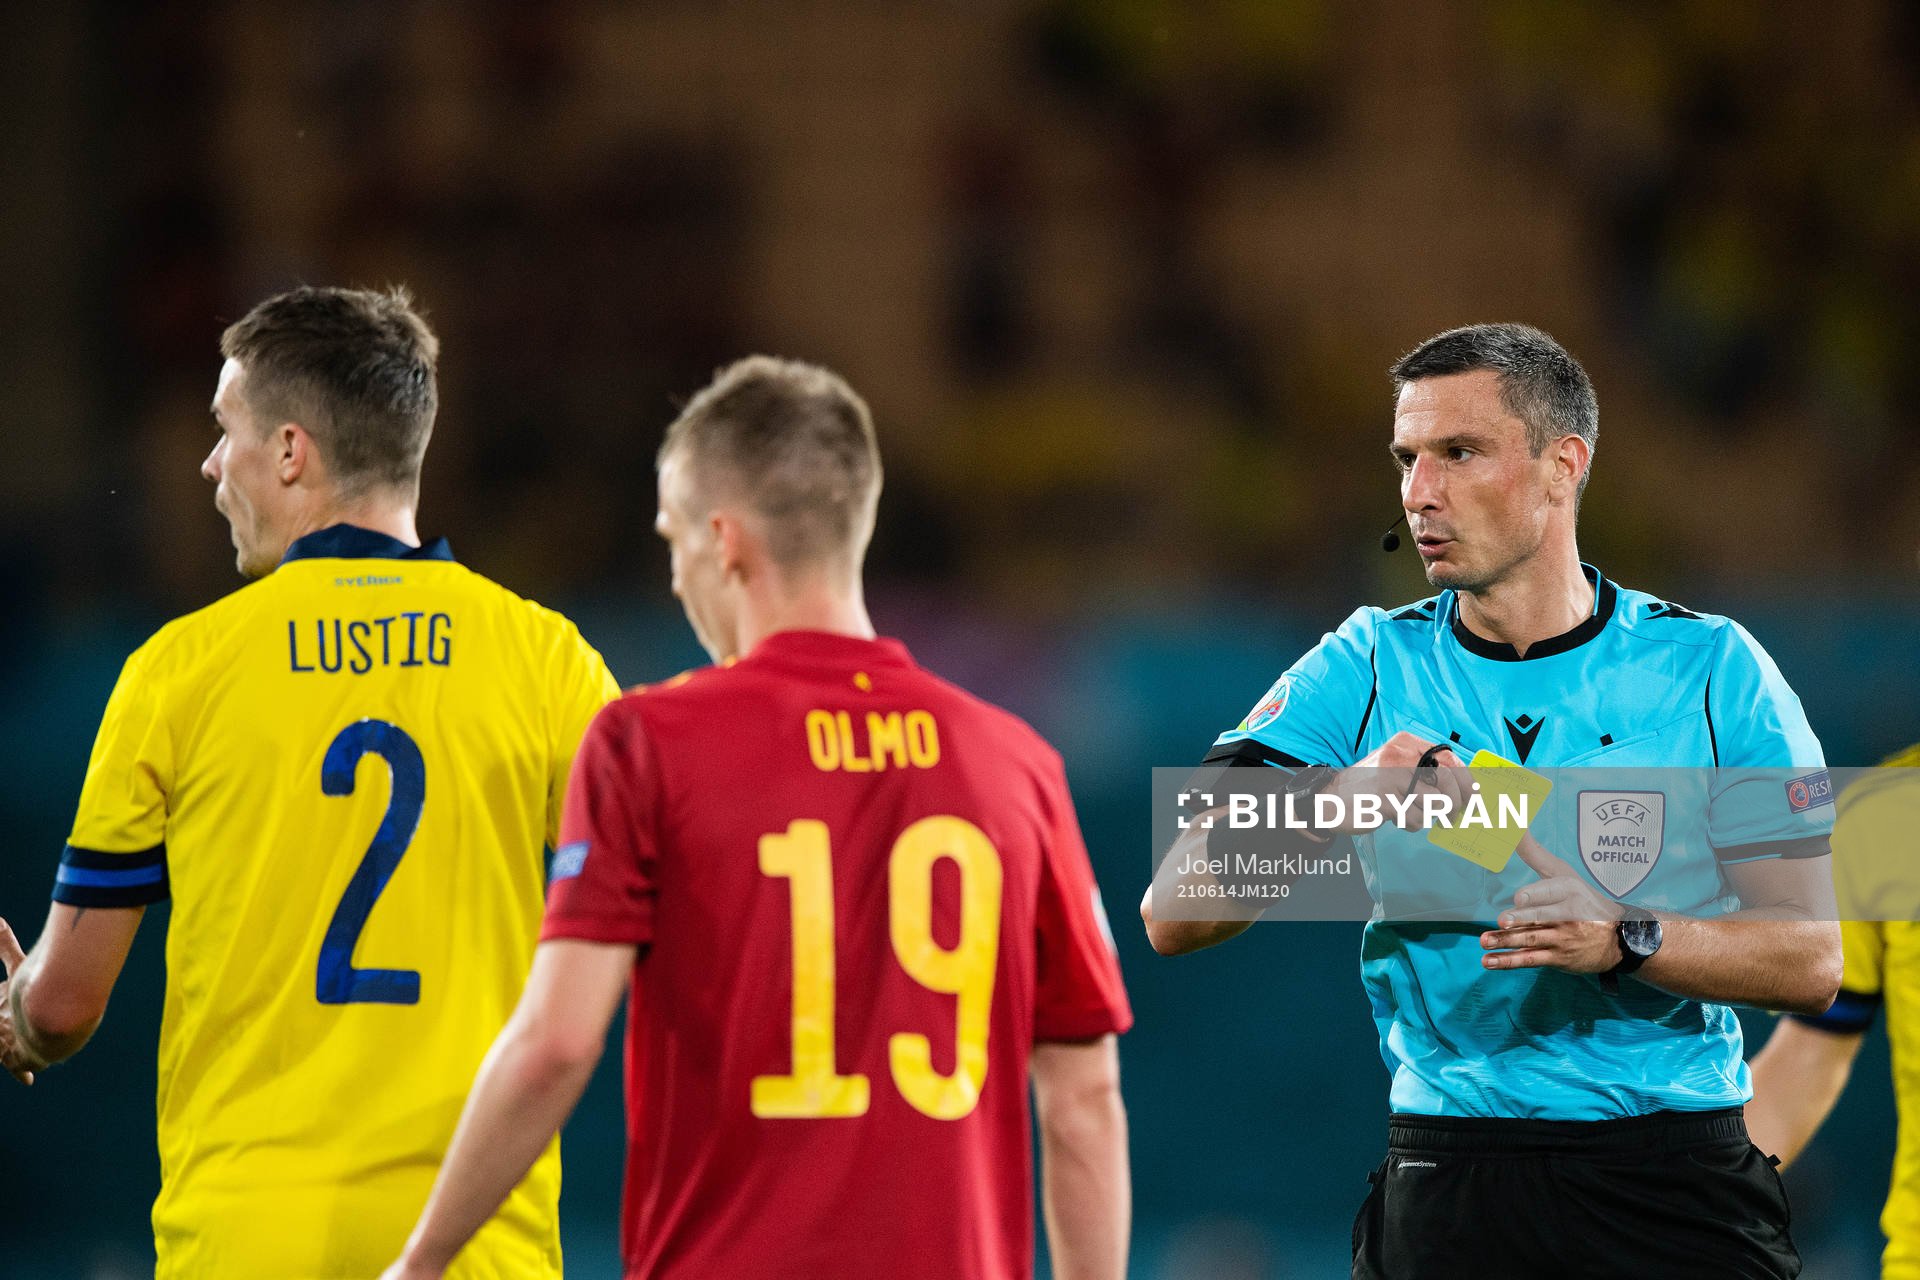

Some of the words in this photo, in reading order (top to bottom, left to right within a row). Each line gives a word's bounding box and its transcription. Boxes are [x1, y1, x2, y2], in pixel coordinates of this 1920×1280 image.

[288, 612, 452, 675] LUSTIG
[805, 709, 941, 772] OLMO
[1596, 803, 1646, 823] UEFA
[1597, 835, 1646, 848] MATCH
[316, 717, 426, 1005] 2
[1591, 851, 1650, 864] OFFICIAL
[750, 814, 1003, 1121] 19
